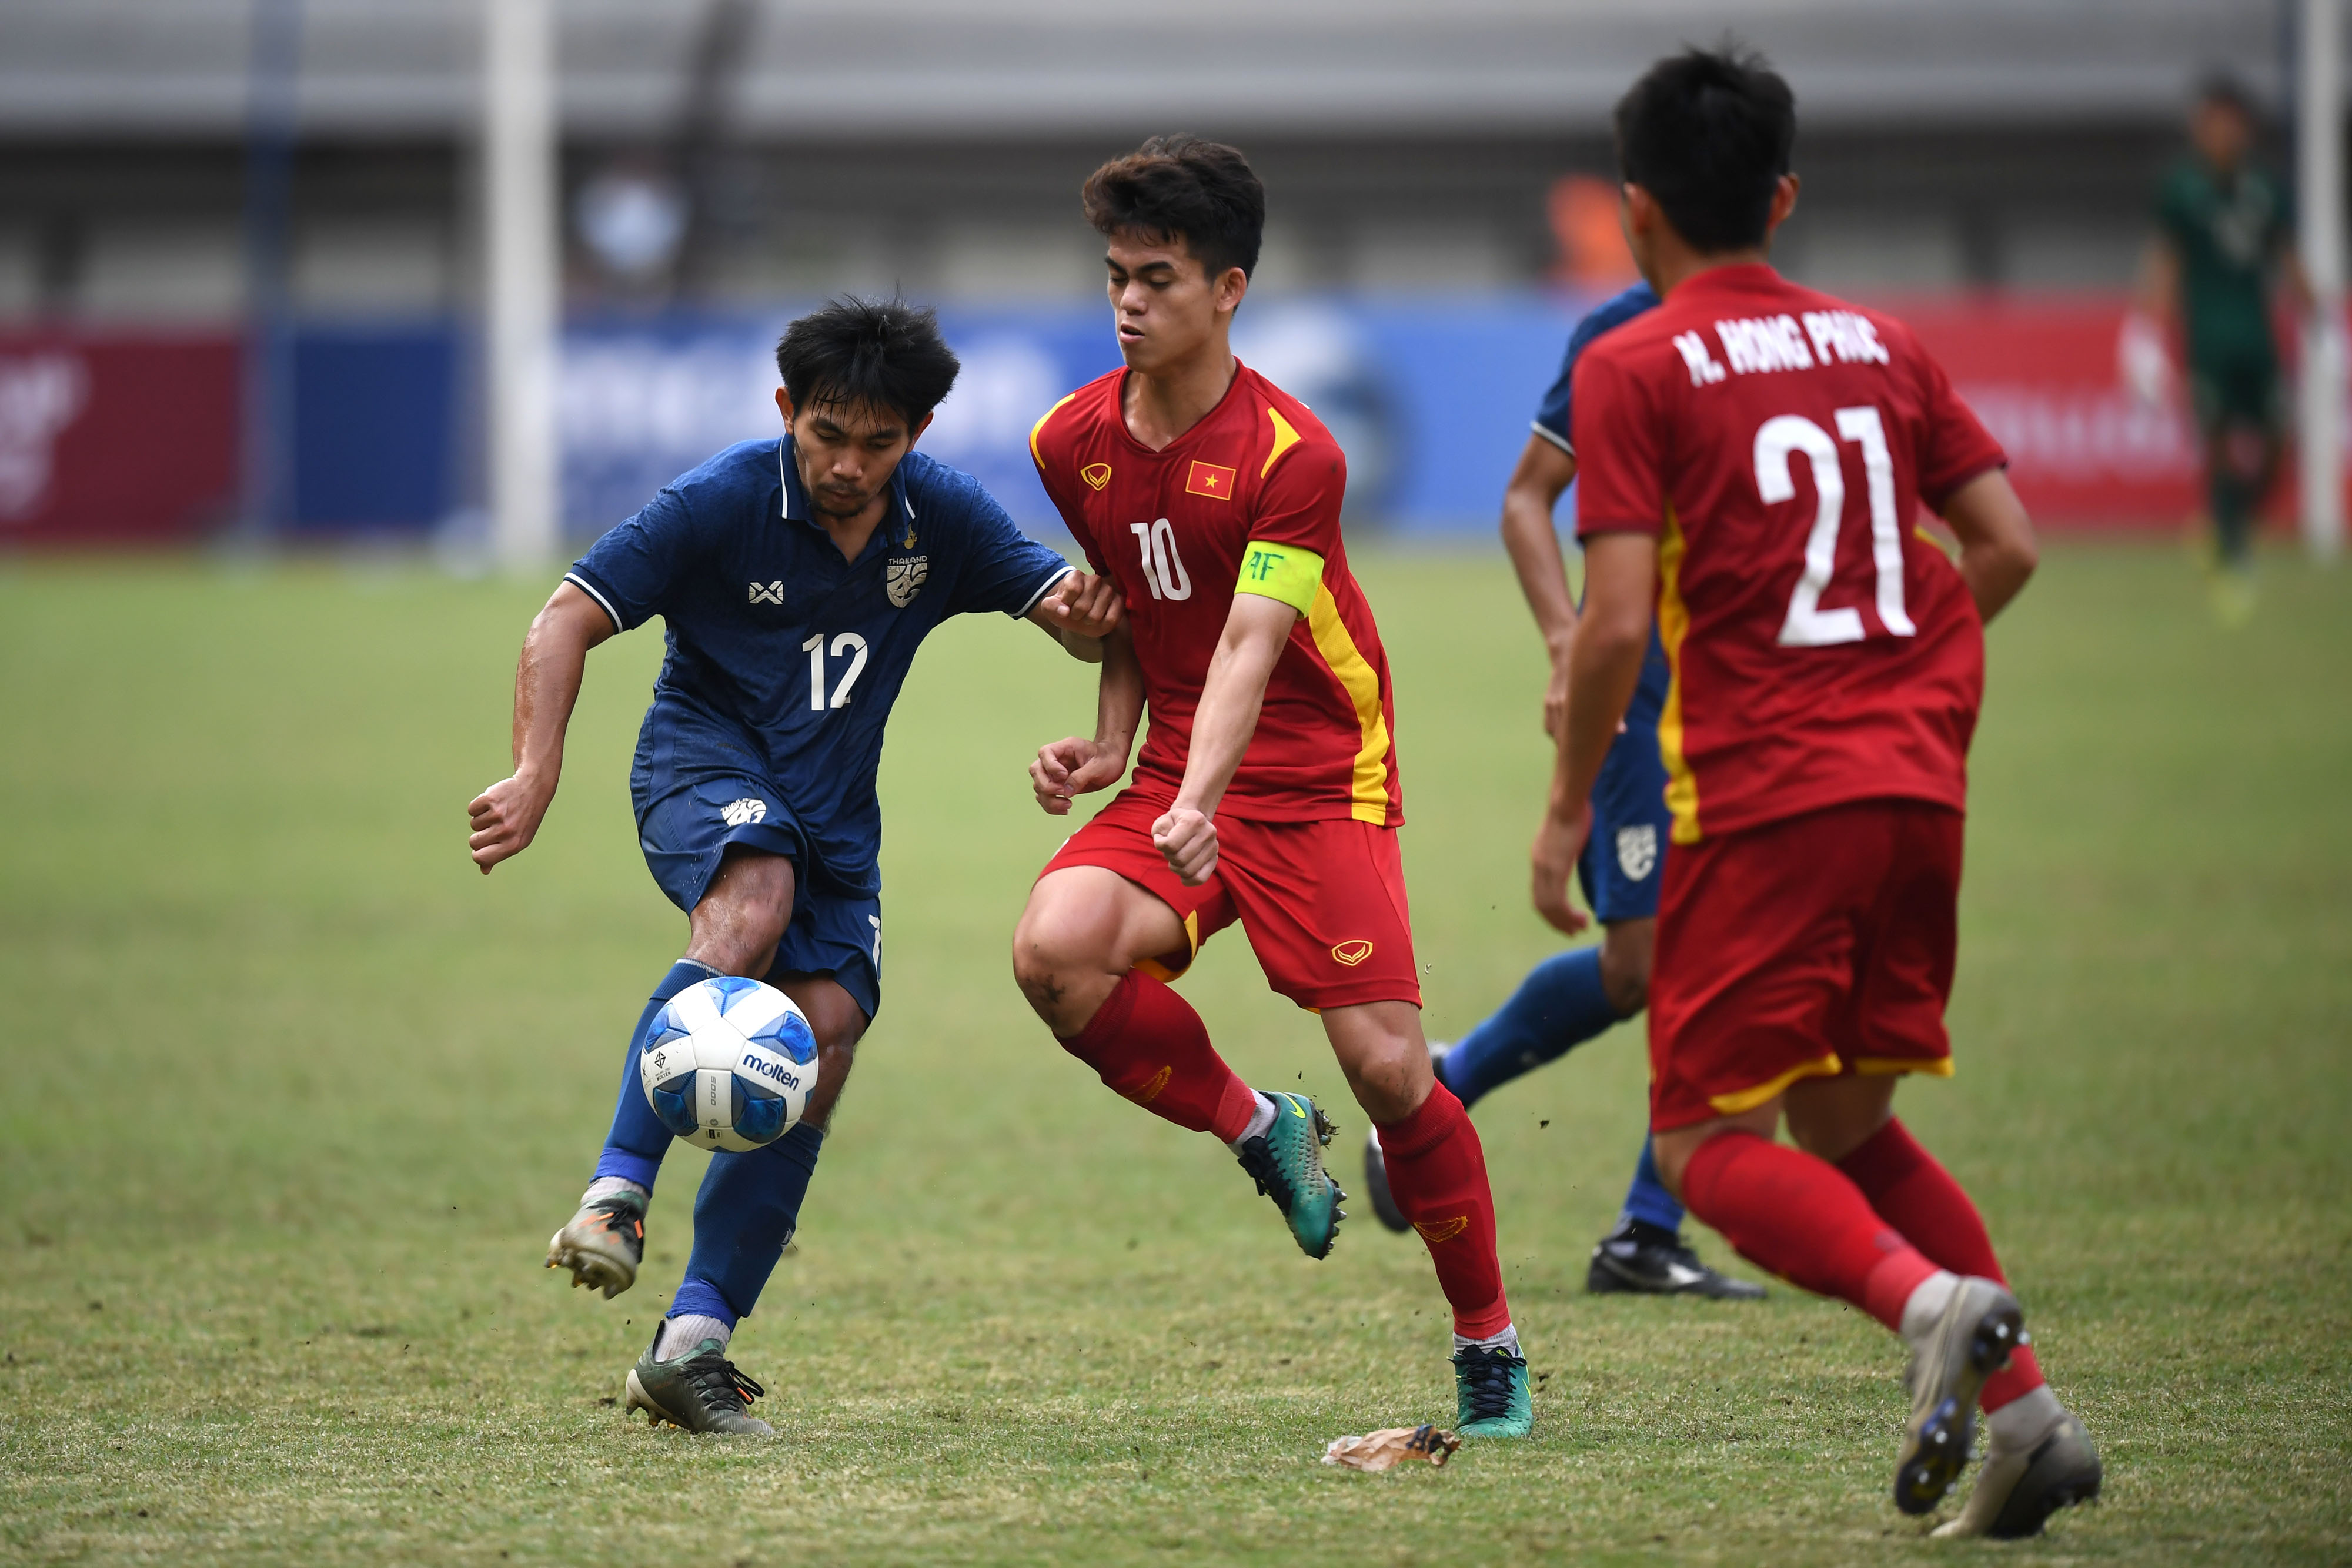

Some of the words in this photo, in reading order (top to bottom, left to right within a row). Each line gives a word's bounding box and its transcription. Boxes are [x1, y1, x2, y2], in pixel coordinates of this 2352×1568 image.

[1715, 313, 1814, 375] HONG
[888, 555, 927, 565] THAILAND
[1130, 518, 1191, 601] 10
[1753, 406, 1916, 646] 21
[802, 632, 868, 711] 12
[743, 1054, 799, 1091] molten
